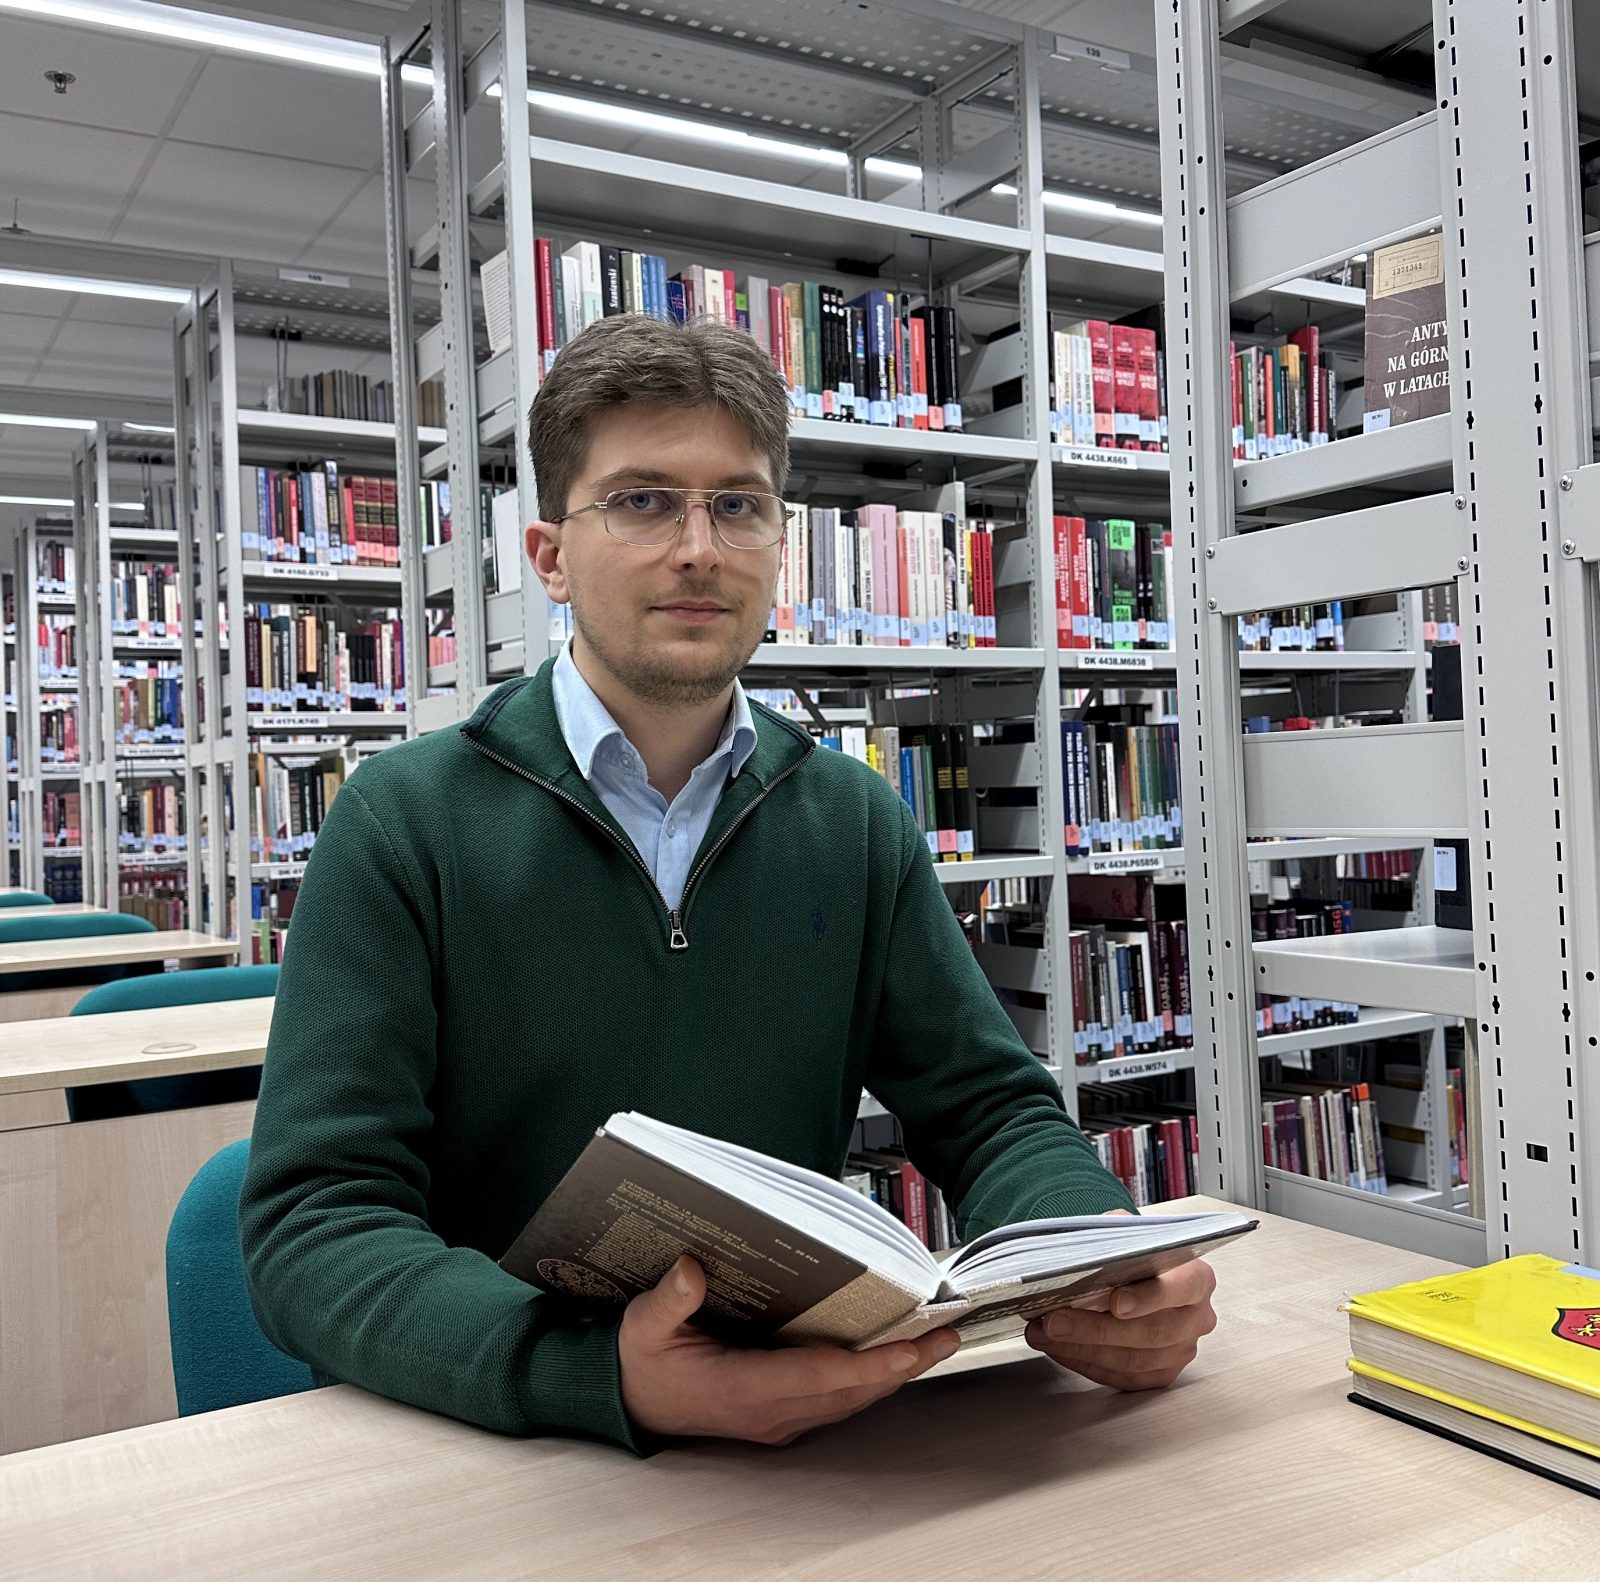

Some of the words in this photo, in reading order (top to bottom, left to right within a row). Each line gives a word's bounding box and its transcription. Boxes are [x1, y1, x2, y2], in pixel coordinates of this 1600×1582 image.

[1387, 355, 1407, 373] NA
[1410, 347, 1449, 369] GÓRN
[1383, 383, 1397, 399] W
[1399, 372, 1450, 395] LATACH
[1071, 452, 1083, 461] DK
[1084, 657, 1096, 665] DK
[1098, 657, 1146, 666] 4438.M6838
[1094, 862, 1106, 870] DK
[1109, 1068, 1121, 1077] DK
[1123, 1061, 1167, 1075] 4438.W574
[774, 1237, 792, 1250] Cena
[804, 1253, 819, 1264] PLN
